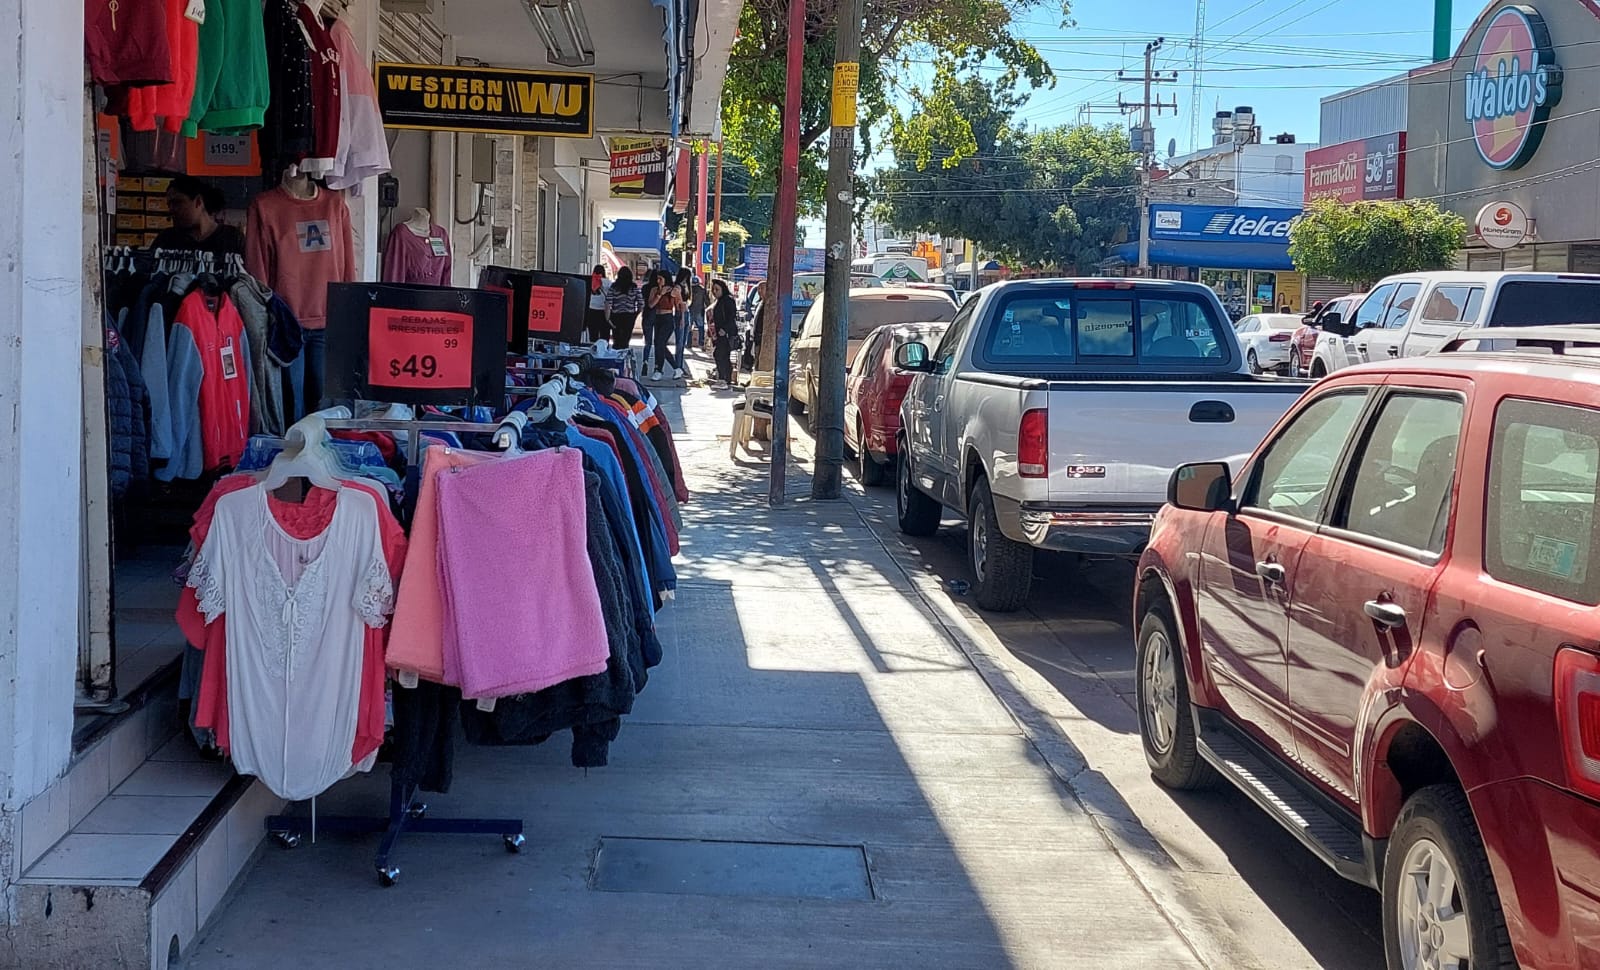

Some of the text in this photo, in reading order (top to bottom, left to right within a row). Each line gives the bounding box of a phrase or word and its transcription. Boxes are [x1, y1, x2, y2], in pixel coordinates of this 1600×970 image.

[387, 75, 503, 95] WESTERN
[1466, 53, 1547, 120] Waldo's
[423, 93, 502, 112] UNION
[517, 82, 582, 116] WU
[629, 152, 662, 165] PUEDES
[1309, 160, 1357, 188] FarmaCon
[306, 225, 325, 247] A
[387, 324, 460, 335] IRRESISTIBLES
[400, 315, 447, 325] REBAJAS
[444, 338, 458, 349] 99
[389, 354, 443, 378] $49.
